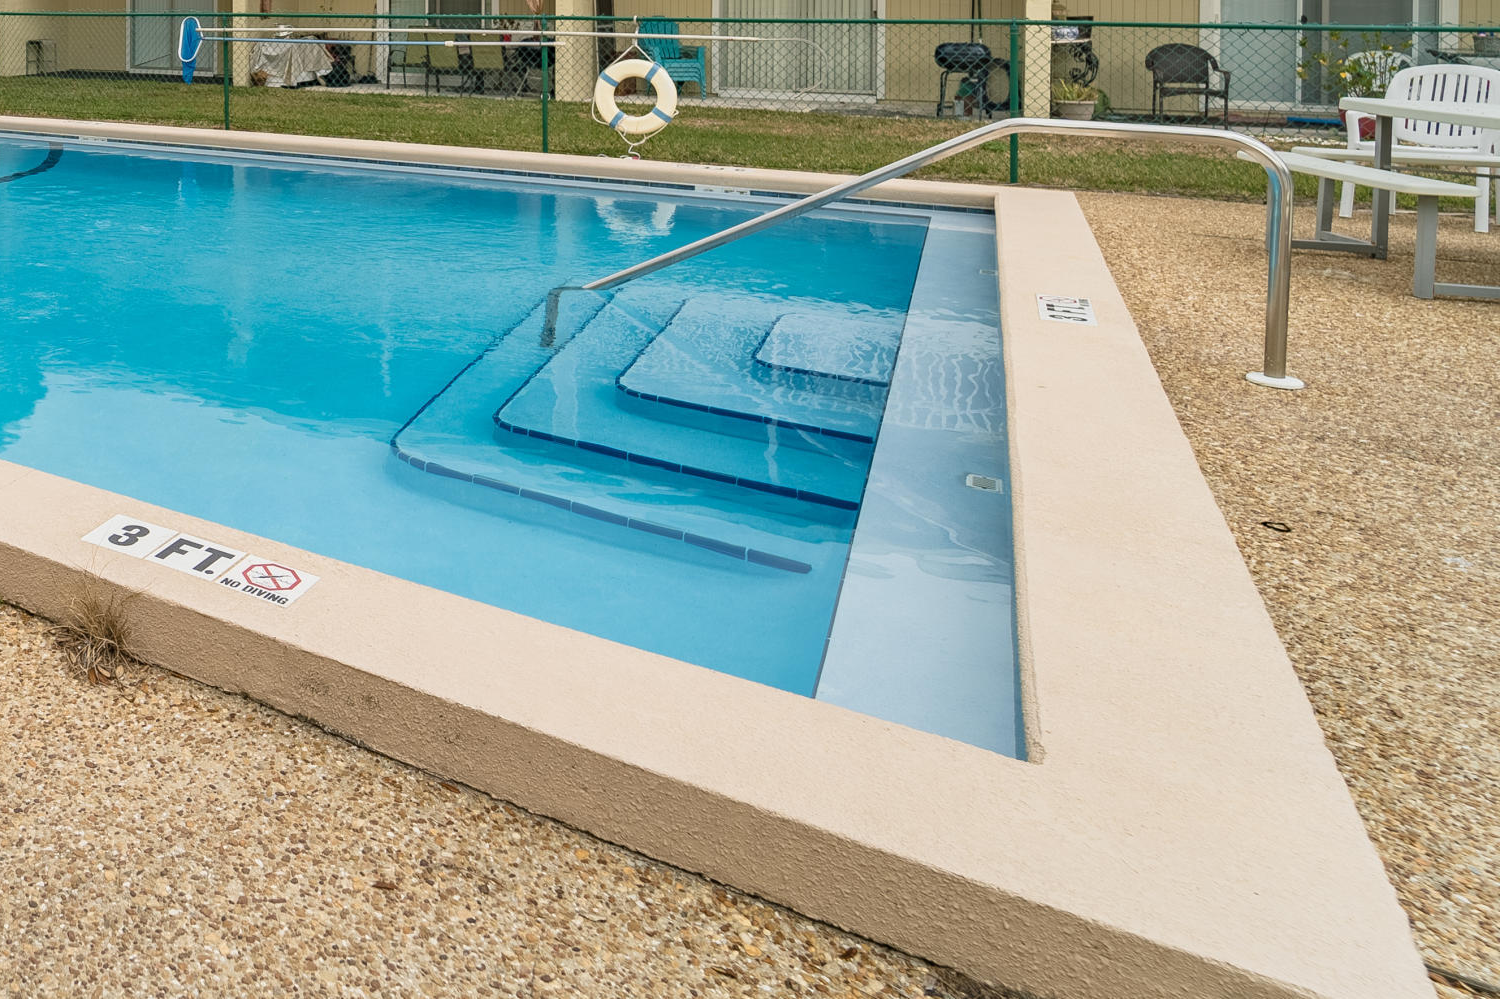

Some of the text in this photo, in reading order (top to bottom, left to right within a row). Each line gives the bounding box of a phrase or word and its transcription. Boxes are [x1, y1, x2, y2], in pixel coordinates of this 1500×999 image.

[108, 524, 235, 575] 3 FT.
[220, 577, 289, 606] NO DIVING
